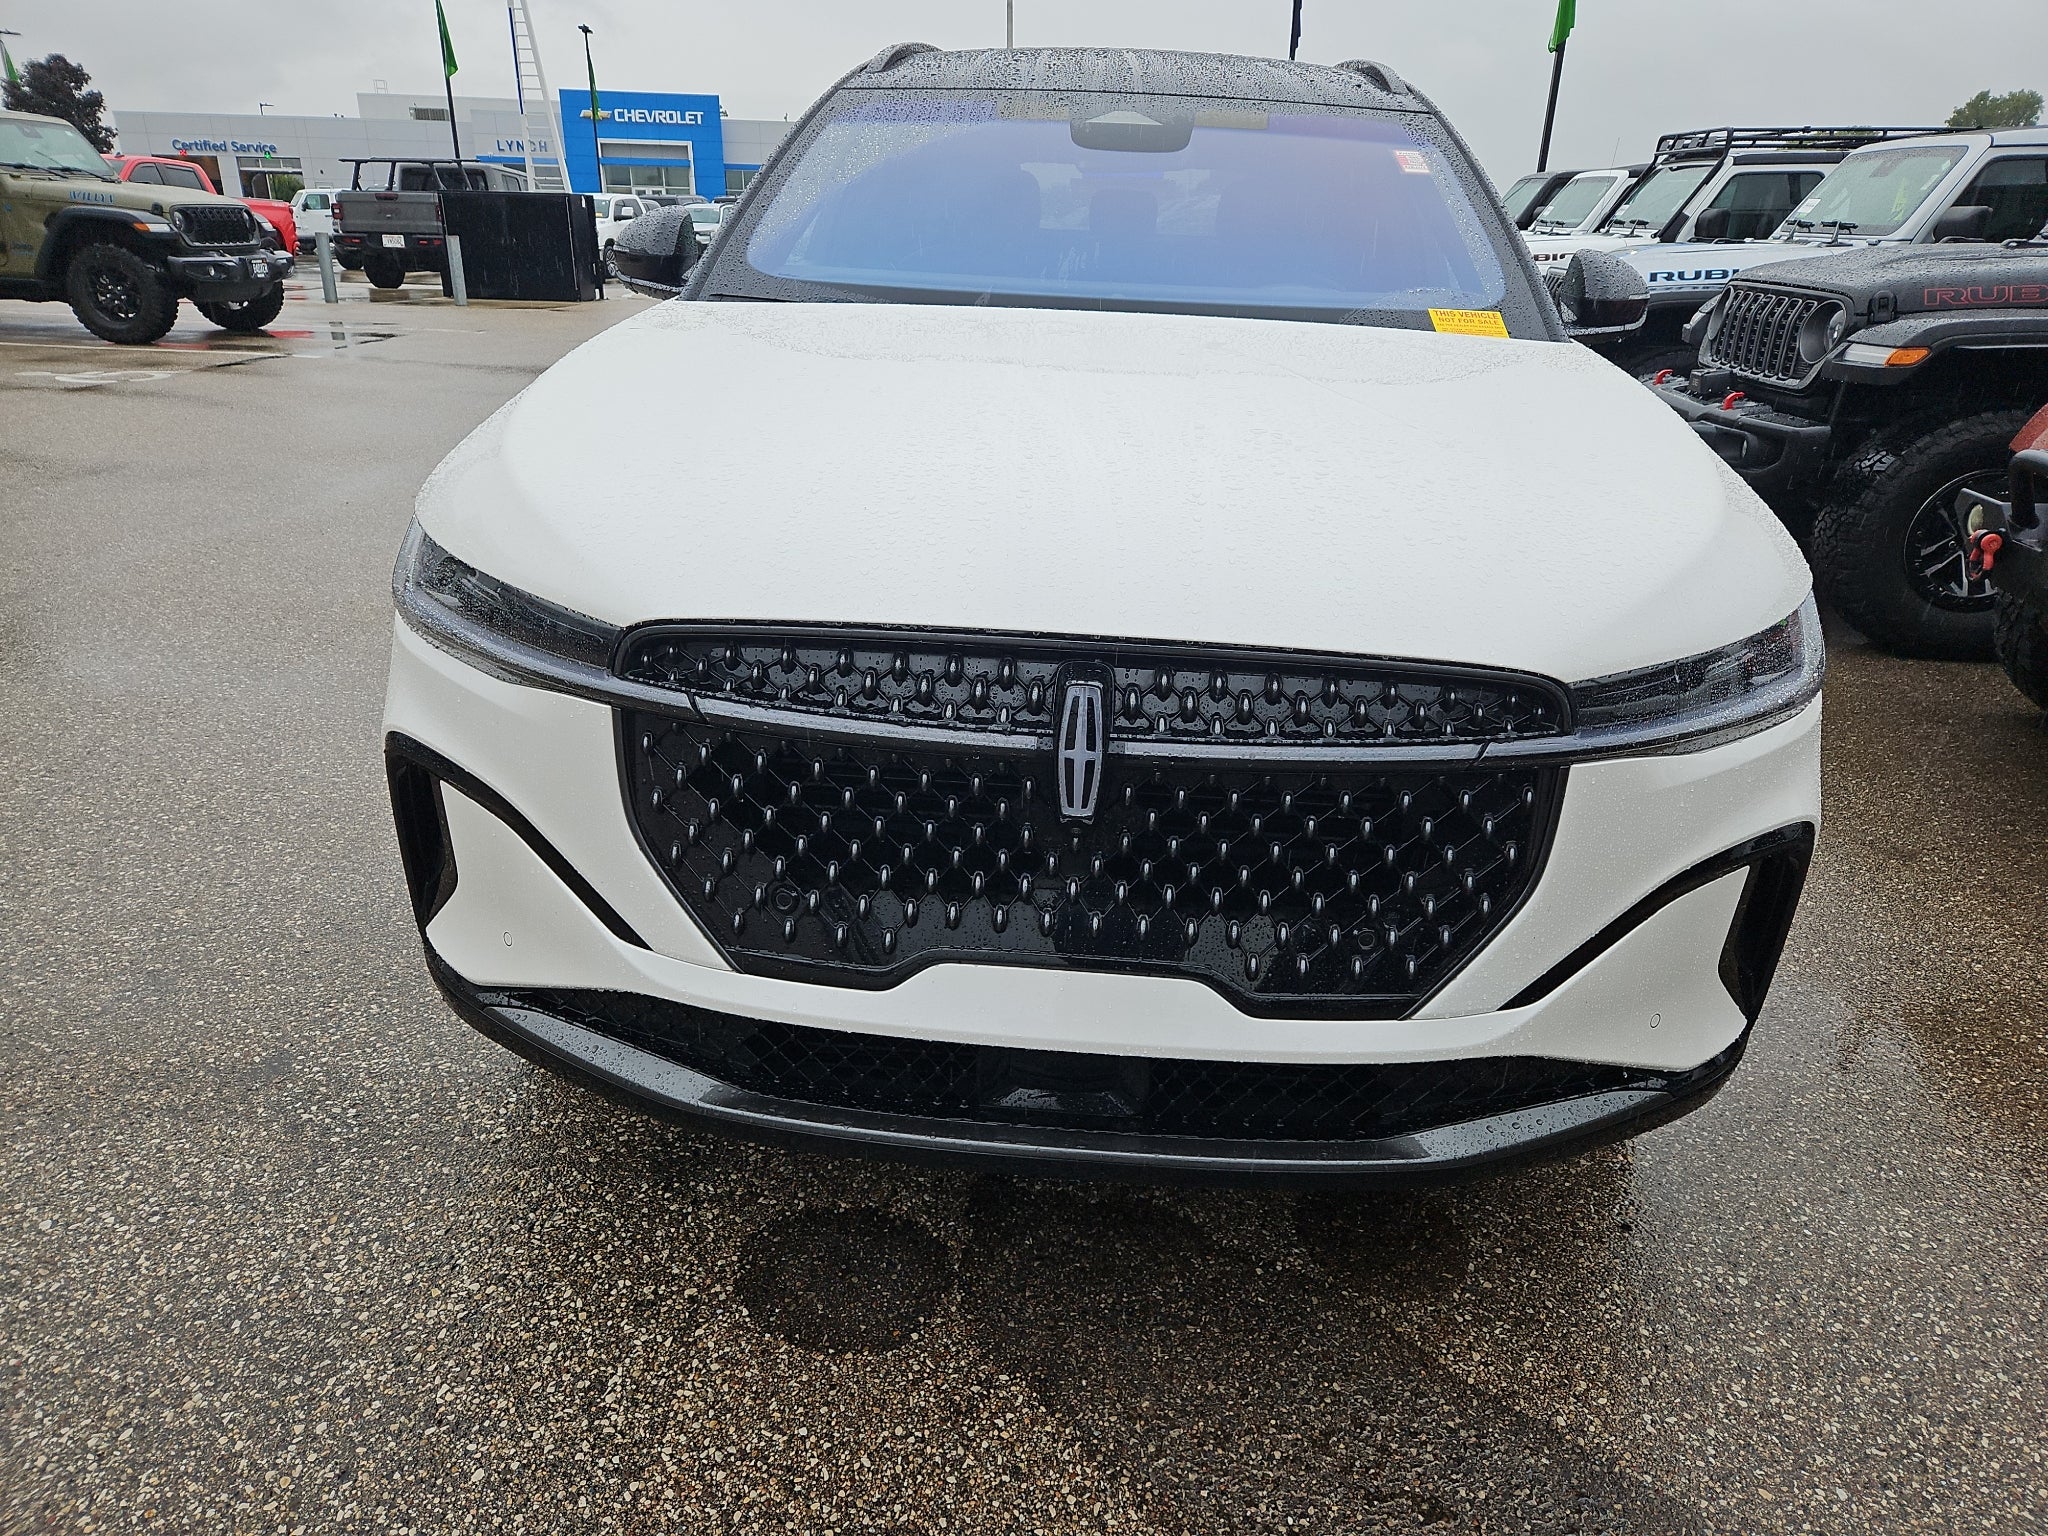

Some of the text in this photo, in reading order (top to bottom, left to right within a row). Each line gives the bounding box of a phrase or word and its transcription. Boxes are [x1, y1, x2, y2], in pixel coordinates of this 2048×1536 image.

[614, 108, 704, 125] CHEVROLET
[172, 138, 277, 153] Certified Service
[1924, 284, 2048, 305] RUB
[1433, 310, 1500, 320] THIS VEHICLE
